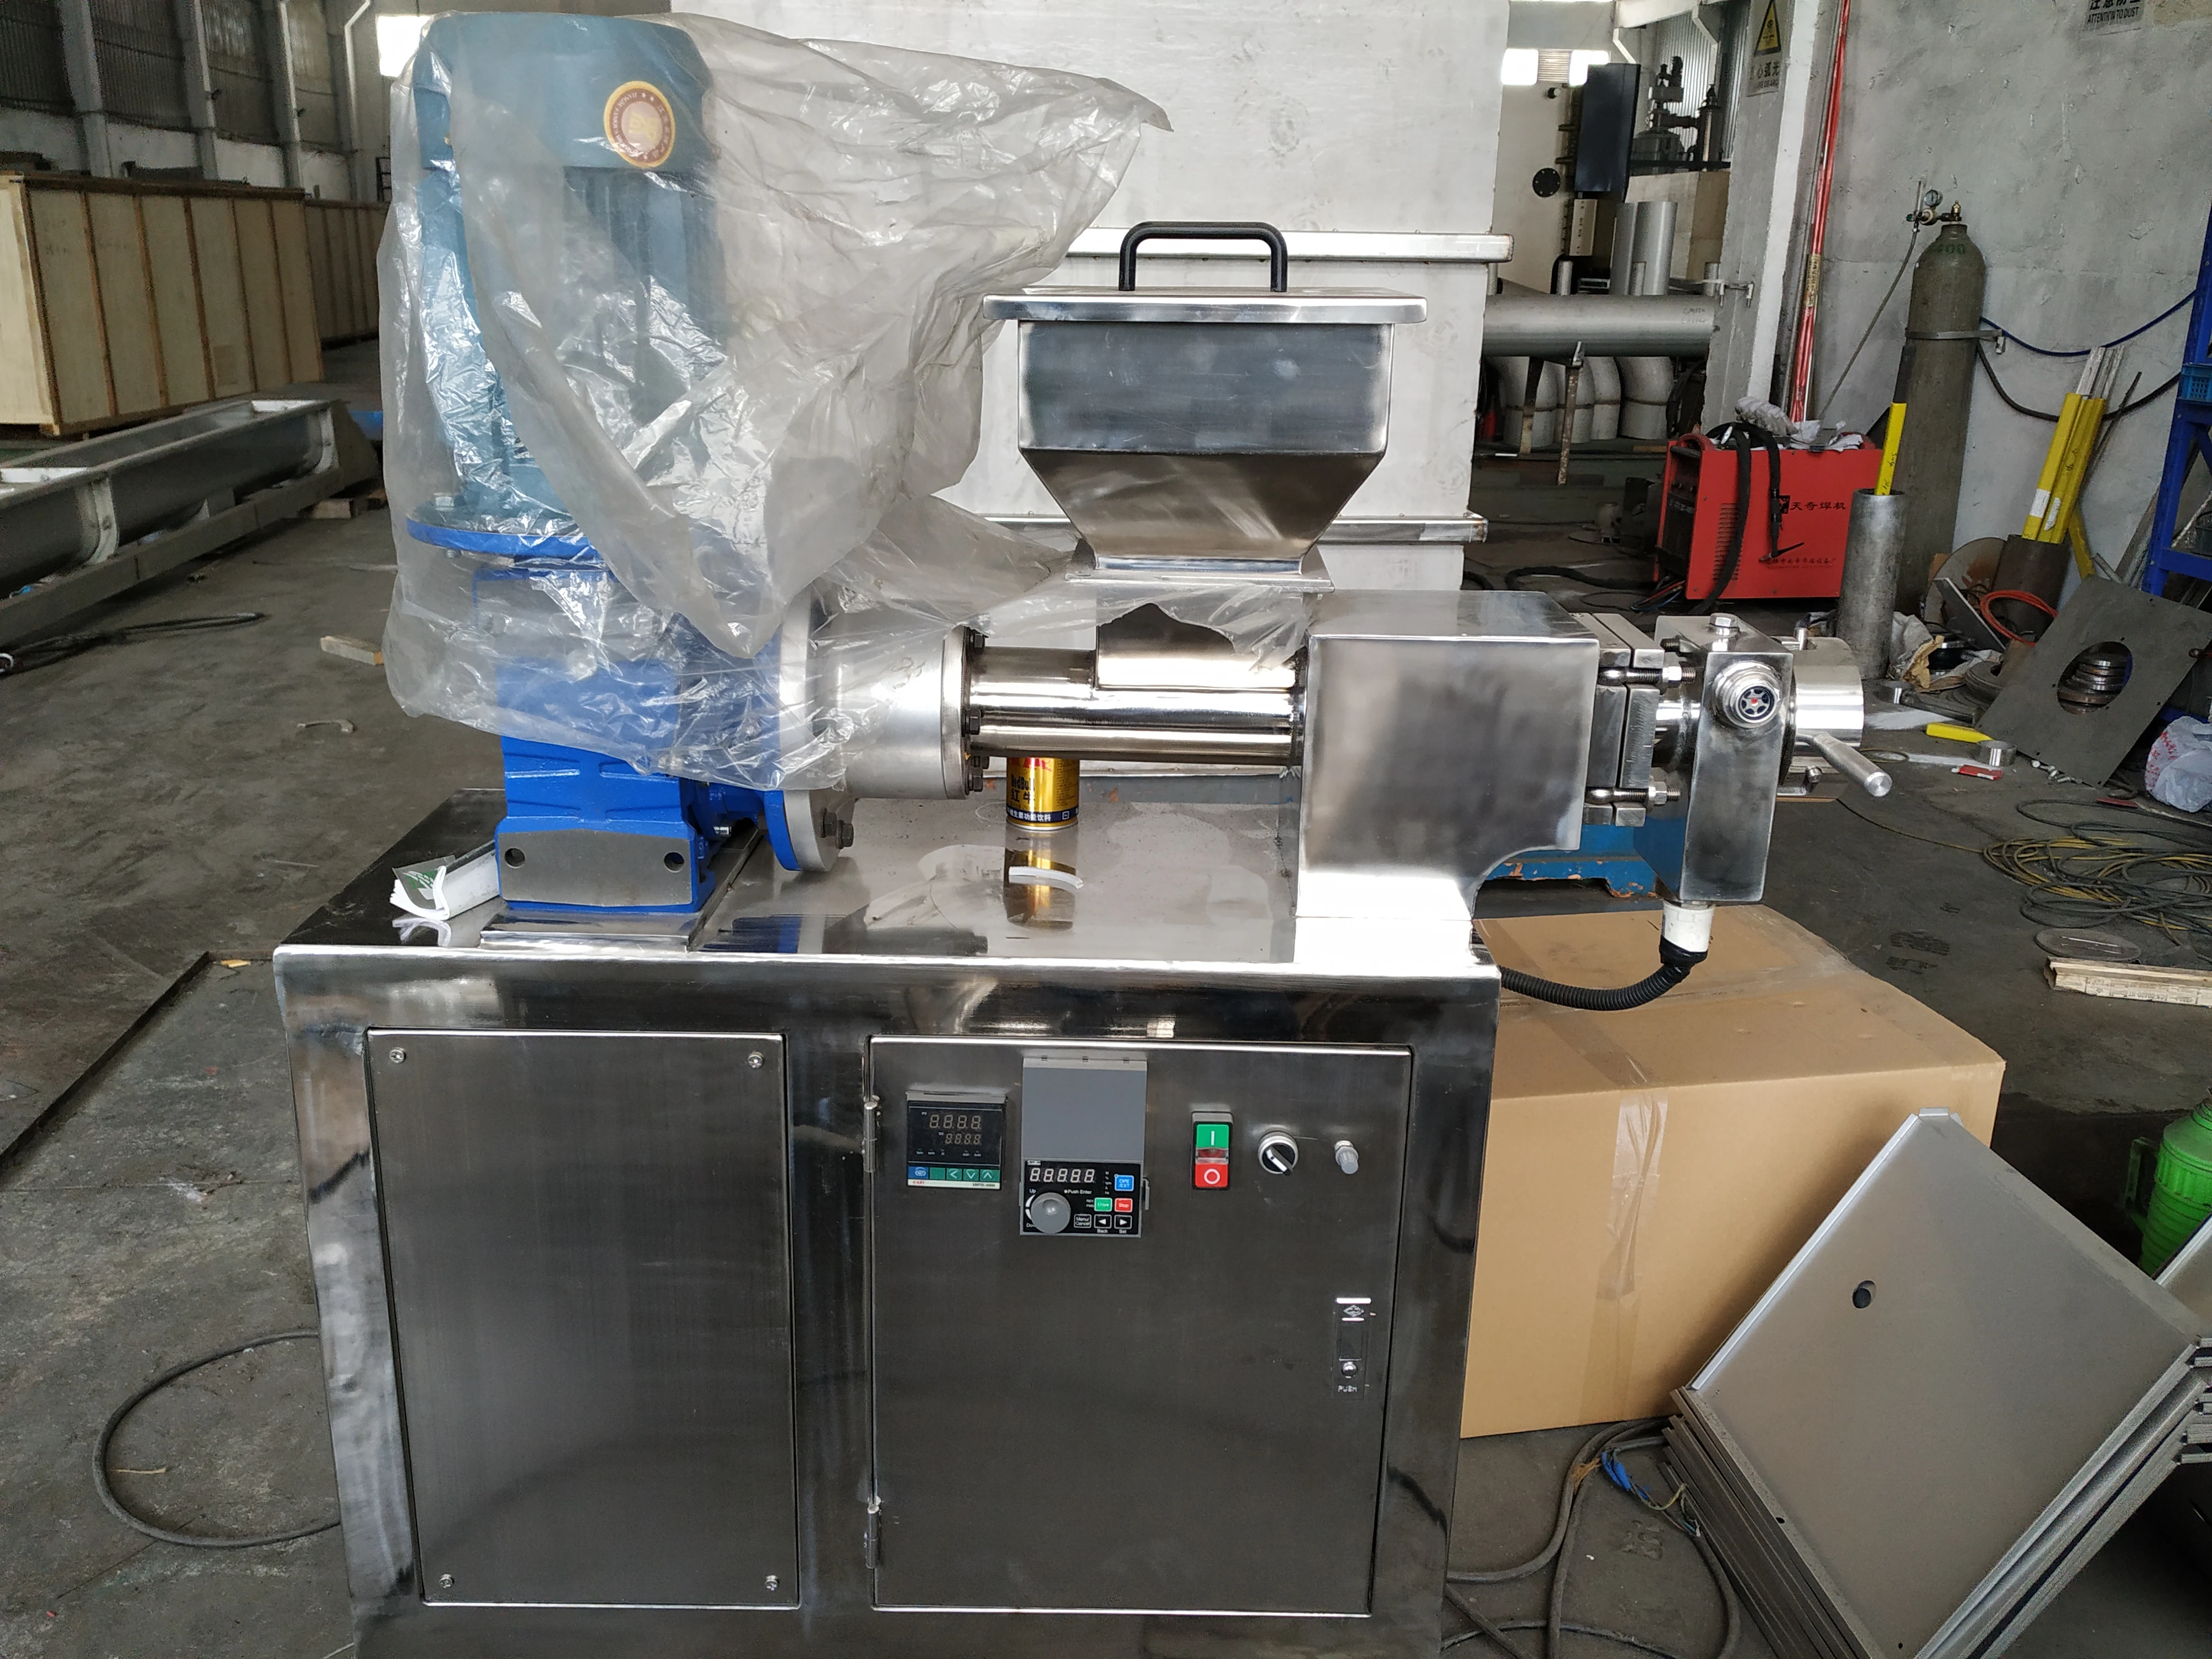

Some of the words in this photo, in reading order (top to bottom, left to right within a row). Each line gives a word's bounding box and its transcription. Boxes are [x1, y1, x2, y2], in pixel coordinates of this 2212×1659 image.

[2124, 7, 2140, 18] DUST
[1790, 502, 1846, 510] 天奇焊机
[1011, 774, 1035, 791] RedBull
[1011, 789, 1035, 804] 红牛
